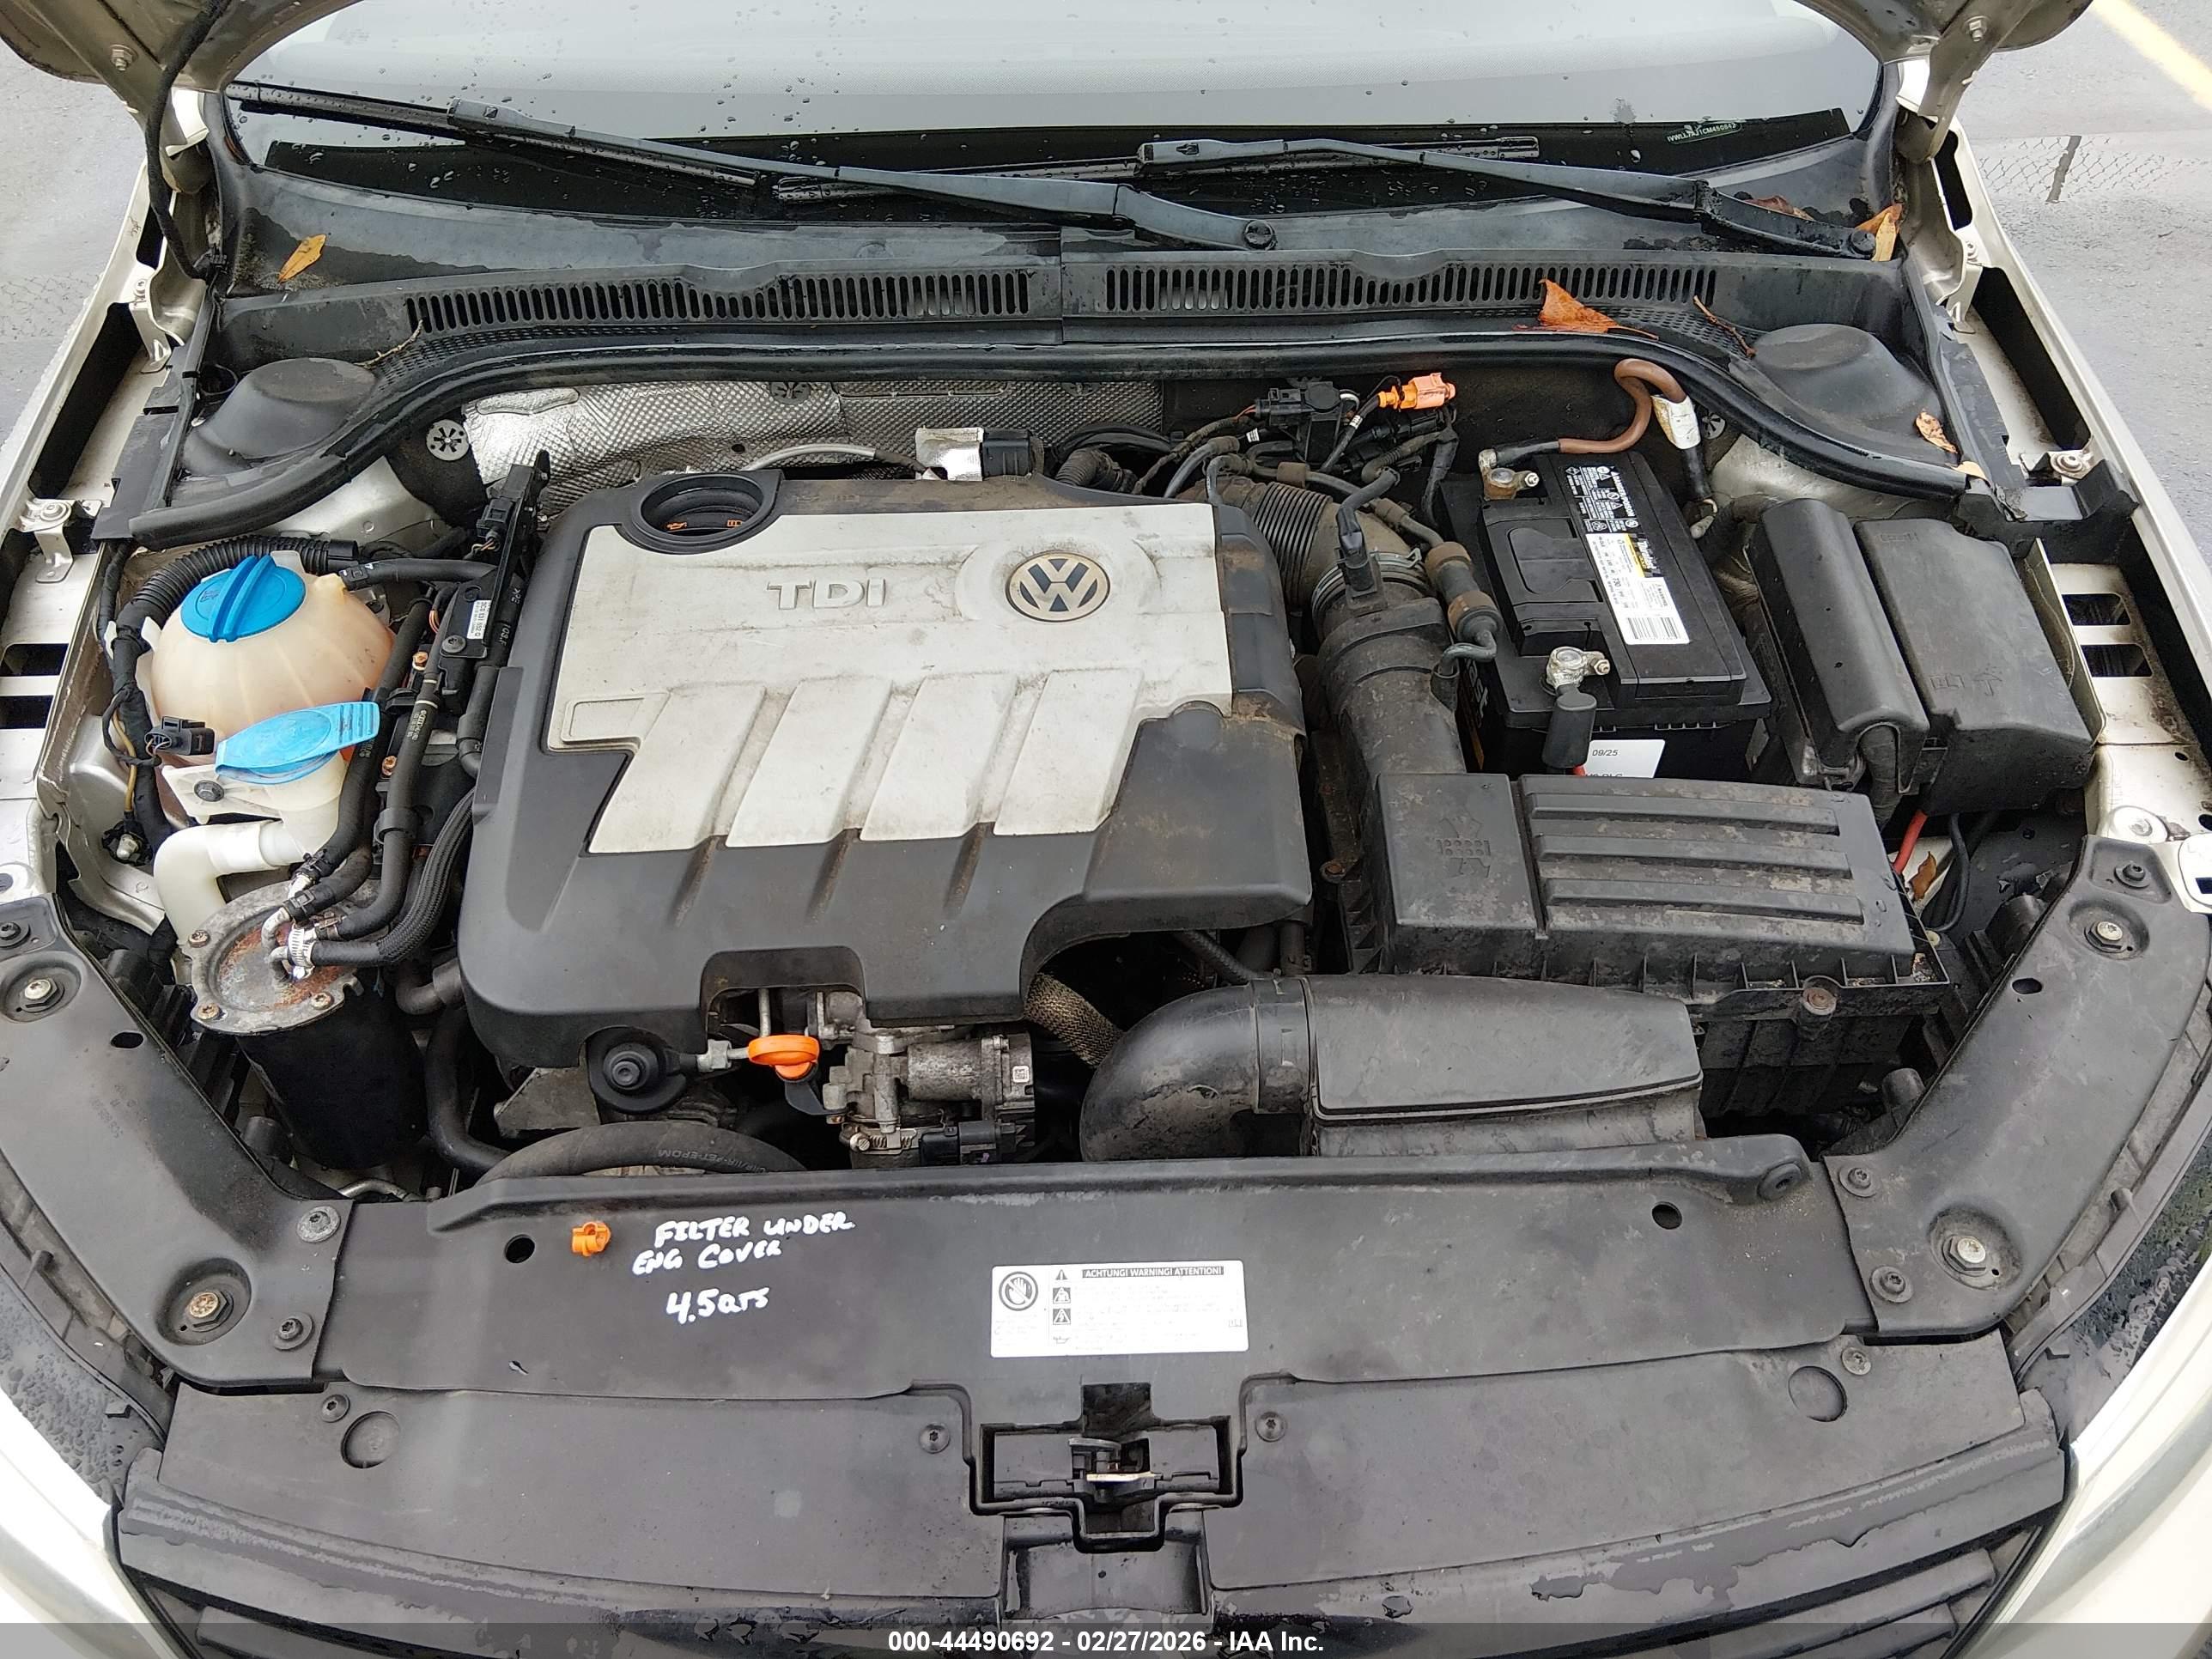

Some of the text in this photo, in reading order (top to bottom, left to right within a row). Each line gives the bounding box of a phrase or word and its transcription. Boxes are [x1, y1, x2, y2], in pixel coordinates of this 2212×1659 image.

[767, 578, 886, 611] TDI
[654, 1212, 855, 1248] FILTER UNDER
[632, 1240, 781, 1275] ENG COVER
[1085, 1267, 1223, 1278] ACHTUNG! WARNING! ATTENTION!
